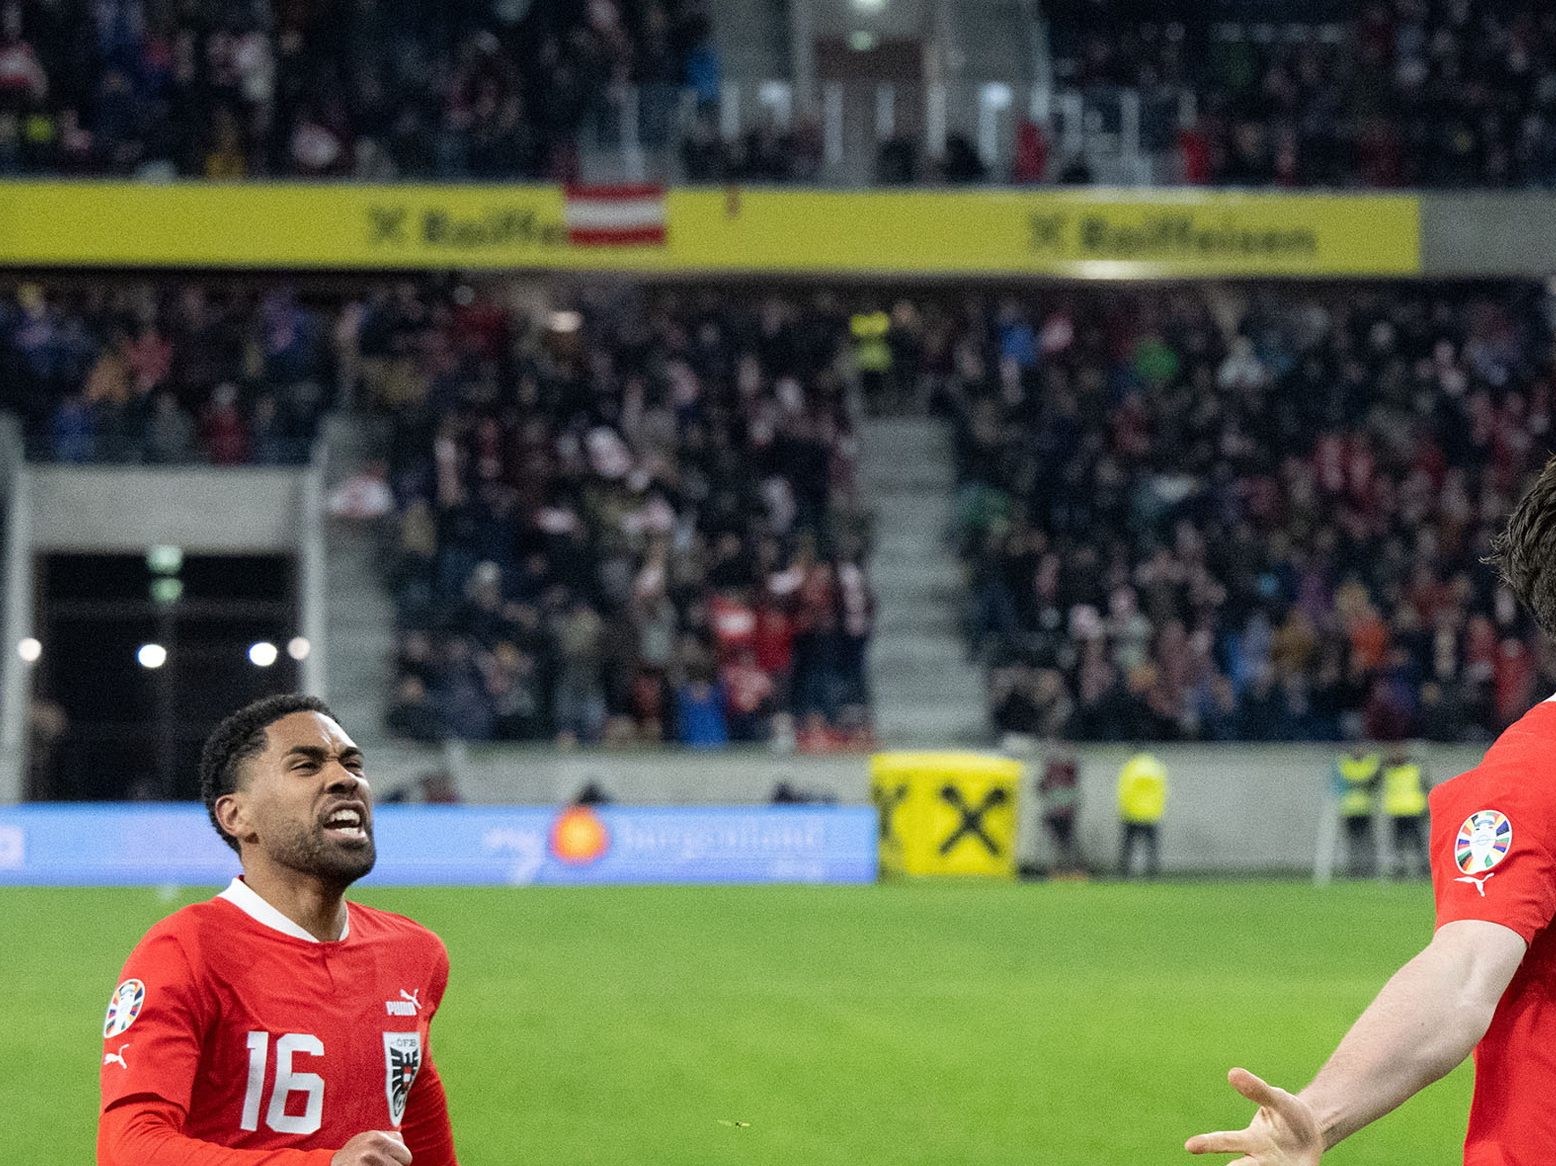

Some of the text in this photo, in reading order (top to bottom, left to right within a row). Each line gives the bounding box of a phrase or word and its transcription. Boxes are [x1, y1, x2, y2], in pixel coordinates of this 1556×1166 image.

[422, 208, 568, 244] Raiffe
[1079, 213, 1315, 255] Raiffeisen
[240, 1030, 326, 1135] 16
